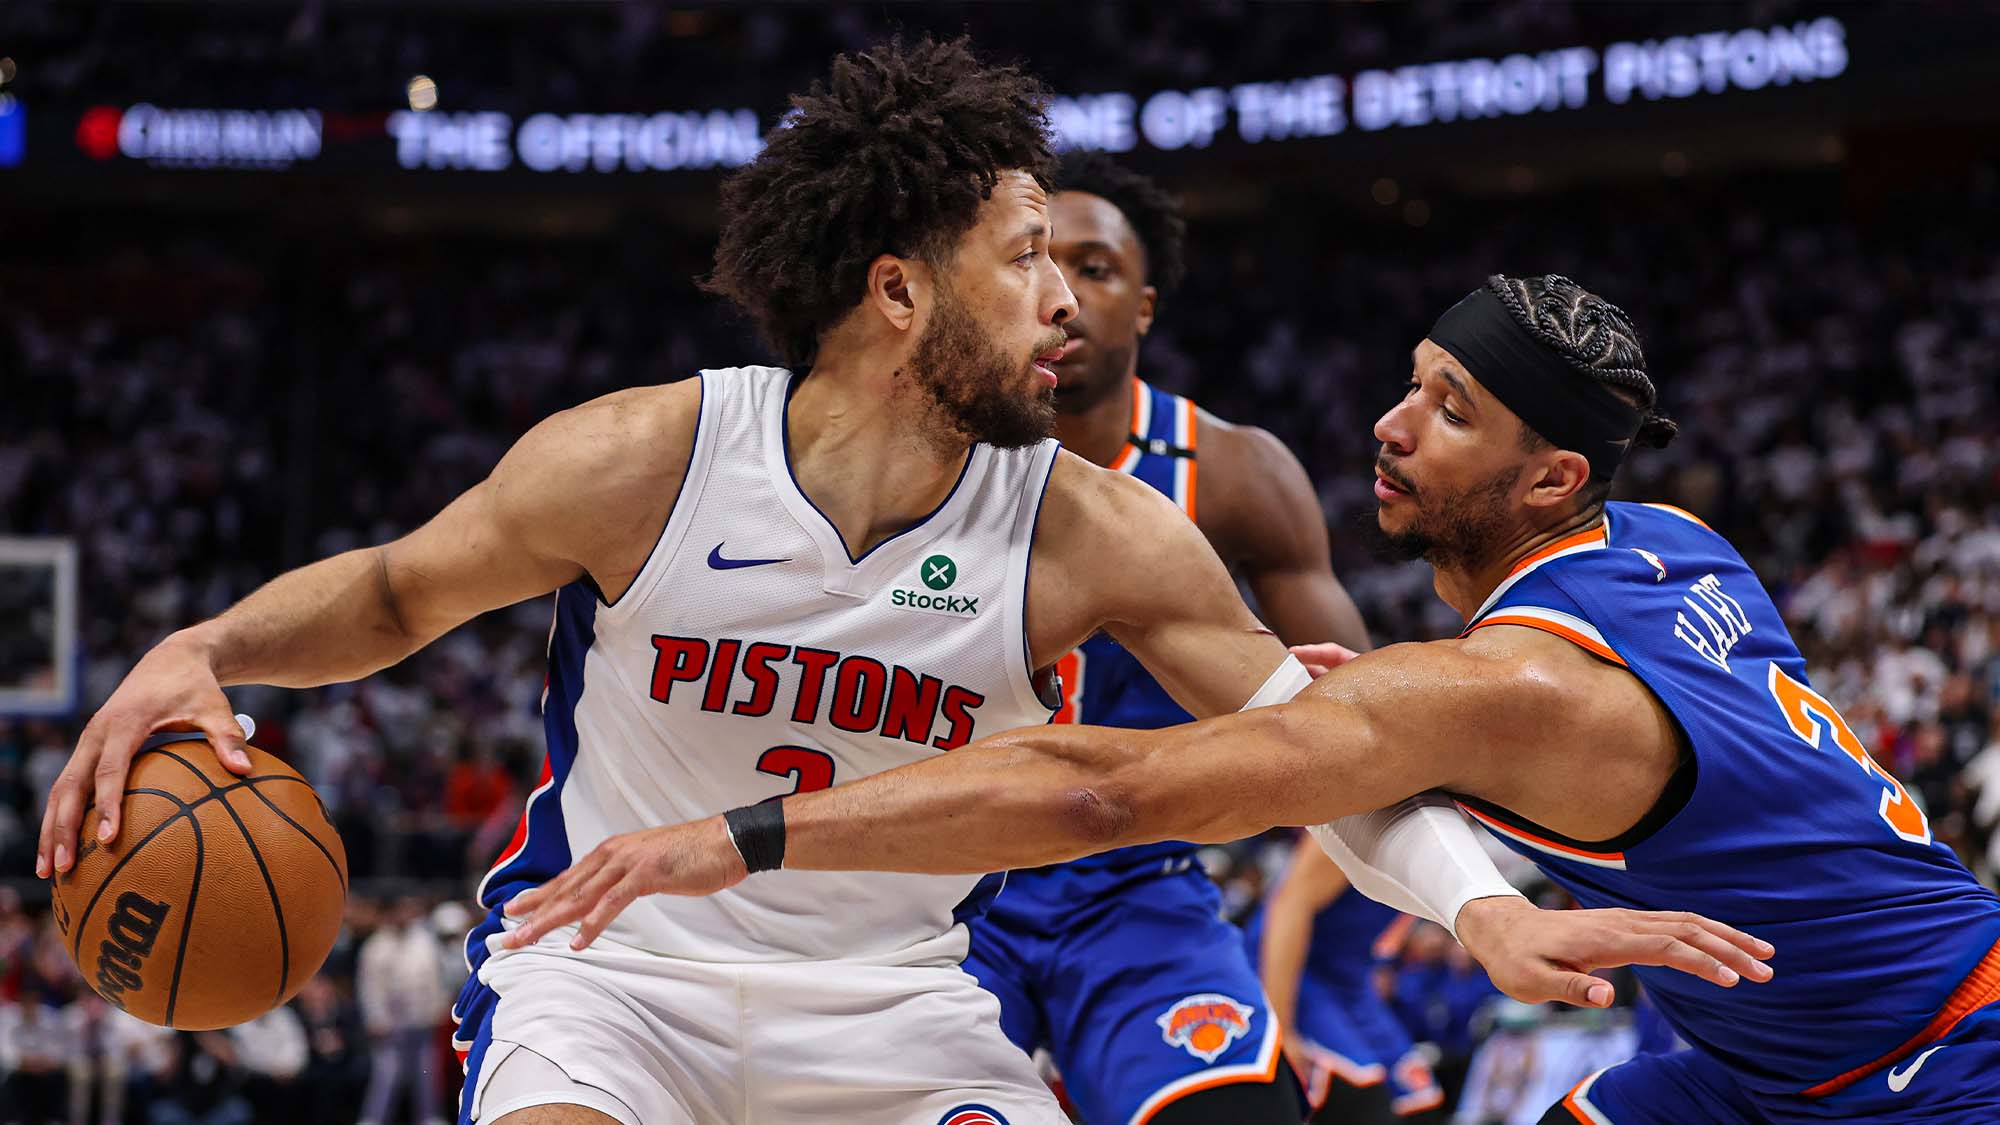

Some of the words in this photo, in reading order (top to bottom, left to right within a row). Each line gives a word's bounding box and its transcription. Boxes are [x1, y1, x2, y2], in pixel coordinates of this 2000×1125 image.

[1142, 85, 1227, 149] OF
[1230, 74, 1346, 143] THE
[1353, 46, 1597, 131] DETROIT
[1603, 16, 1849, 104] PISTONS
[388, 110, 512, 171] THE
[891, 588, 979, 615] StockX
[1674, 573, 1753, 674] HART
[650, 634, 985, 752] PISTONS
[1768, 660, 1931, 846] 3
